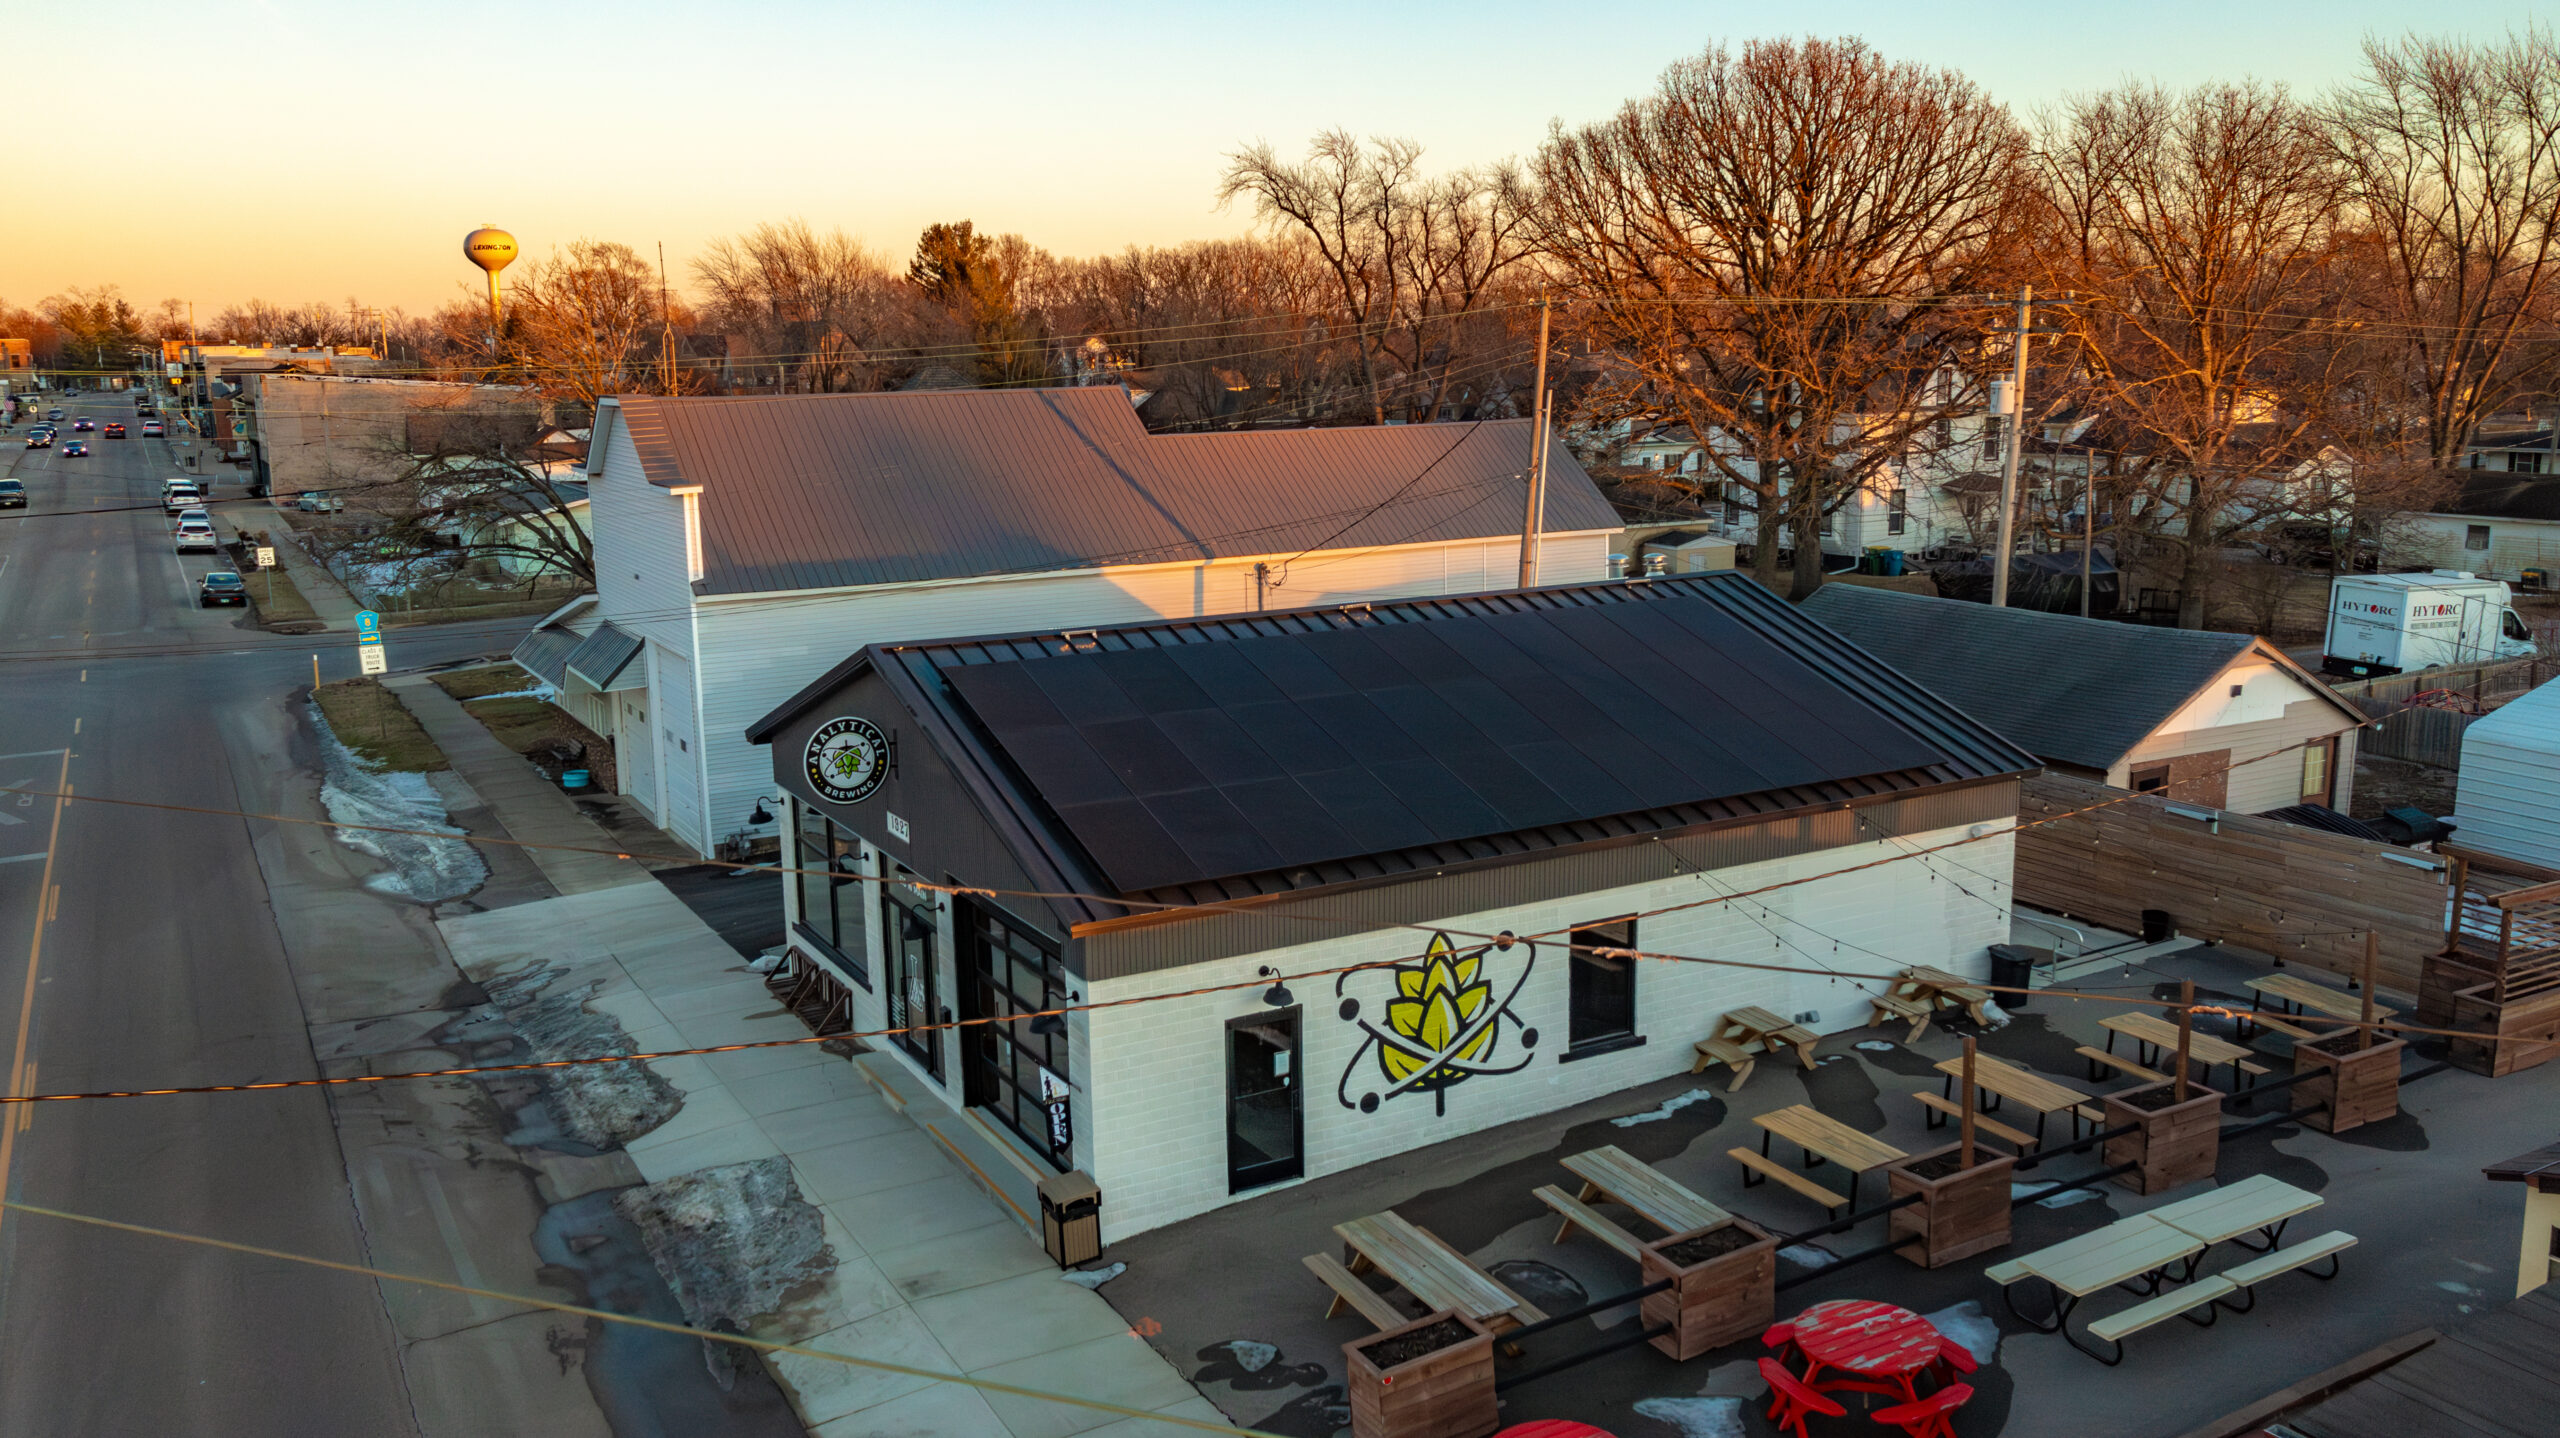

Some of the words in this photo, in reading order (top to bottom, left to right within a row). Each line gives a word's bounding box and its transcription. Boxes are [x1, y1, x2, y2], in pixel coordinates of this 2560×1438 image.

[260, 556, 273, 564] 25
[2342, 600, 2398, 617] HYTORC
[2412, 603, 2462, 617] HYTORC
[808, 721, 885, 765] ANALYTICAL
[824, 780, 874, 799] BREWING
[1050, 1102, 1067, 1146] OPEN
